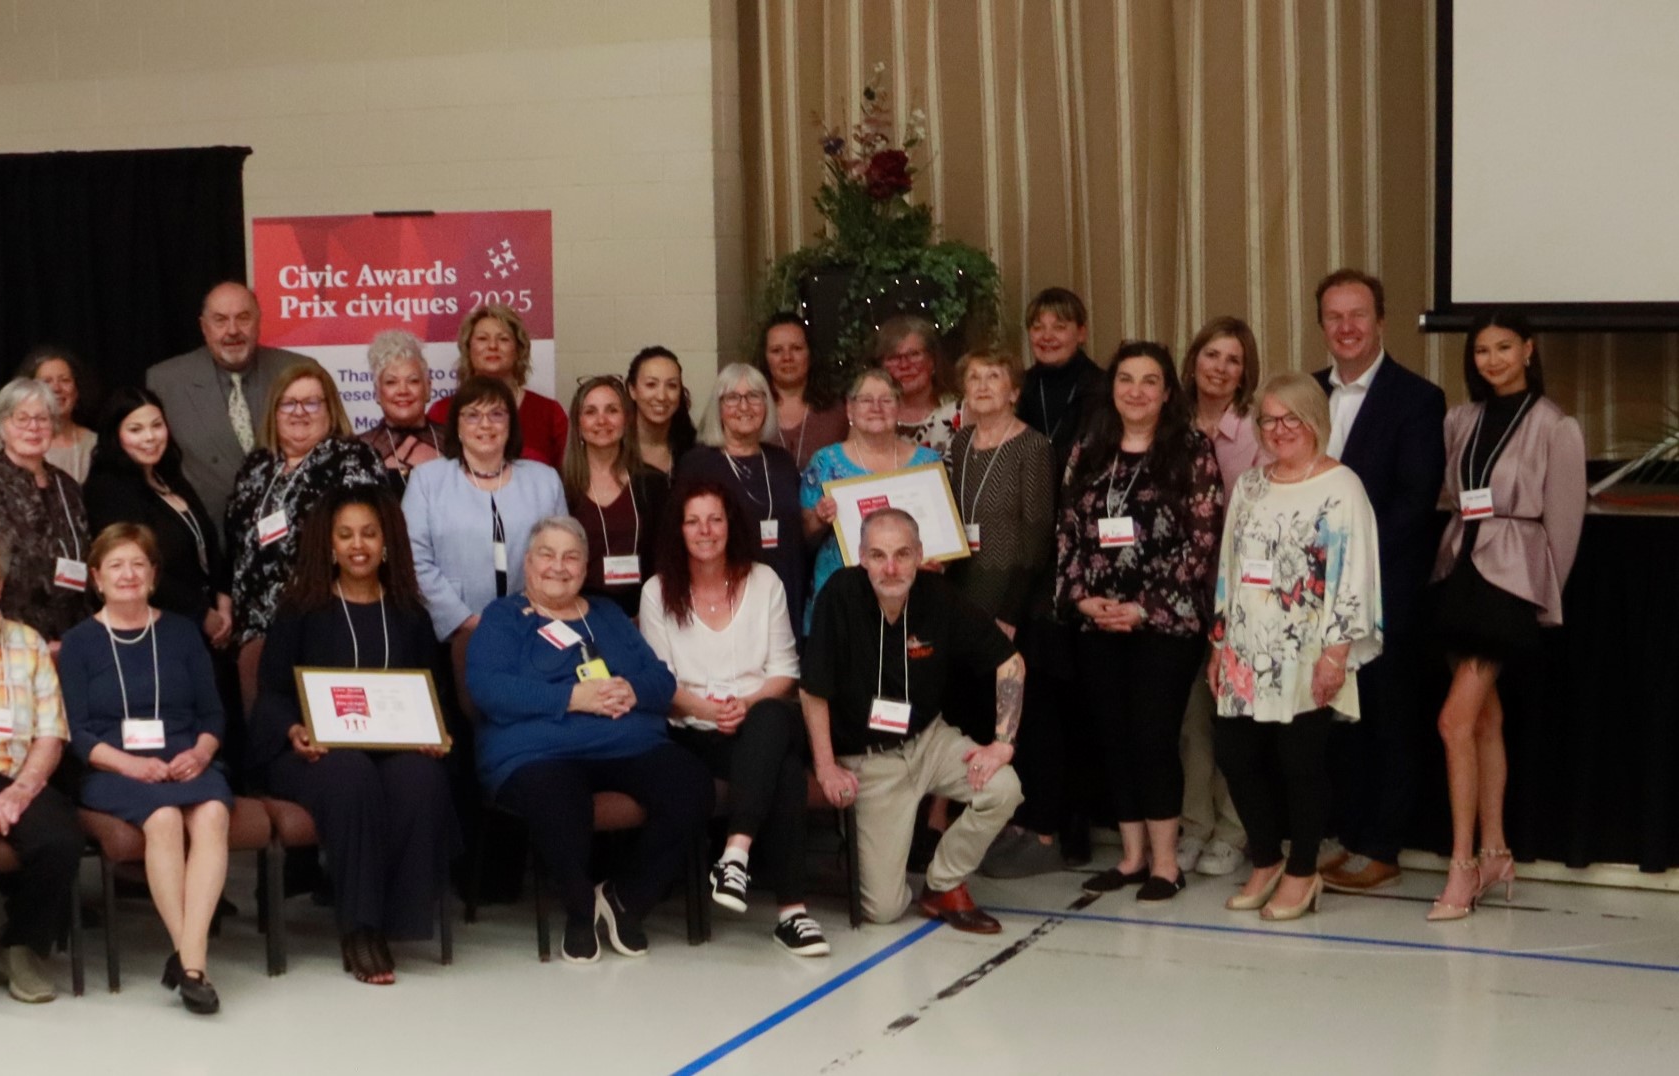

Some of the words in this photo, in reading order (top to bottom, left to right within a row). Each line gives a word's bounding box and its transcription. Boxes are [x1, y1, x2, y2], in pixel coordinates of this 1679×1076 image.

[278, 264, 349, 289] Civic
[355, 260, 458, 287] Awards
[279, 294, 338, 319] Prix
[345, 292, 459, 322] civiques
[469, 289, 532, 313] 2025
[428, 368, 445, 381] to
